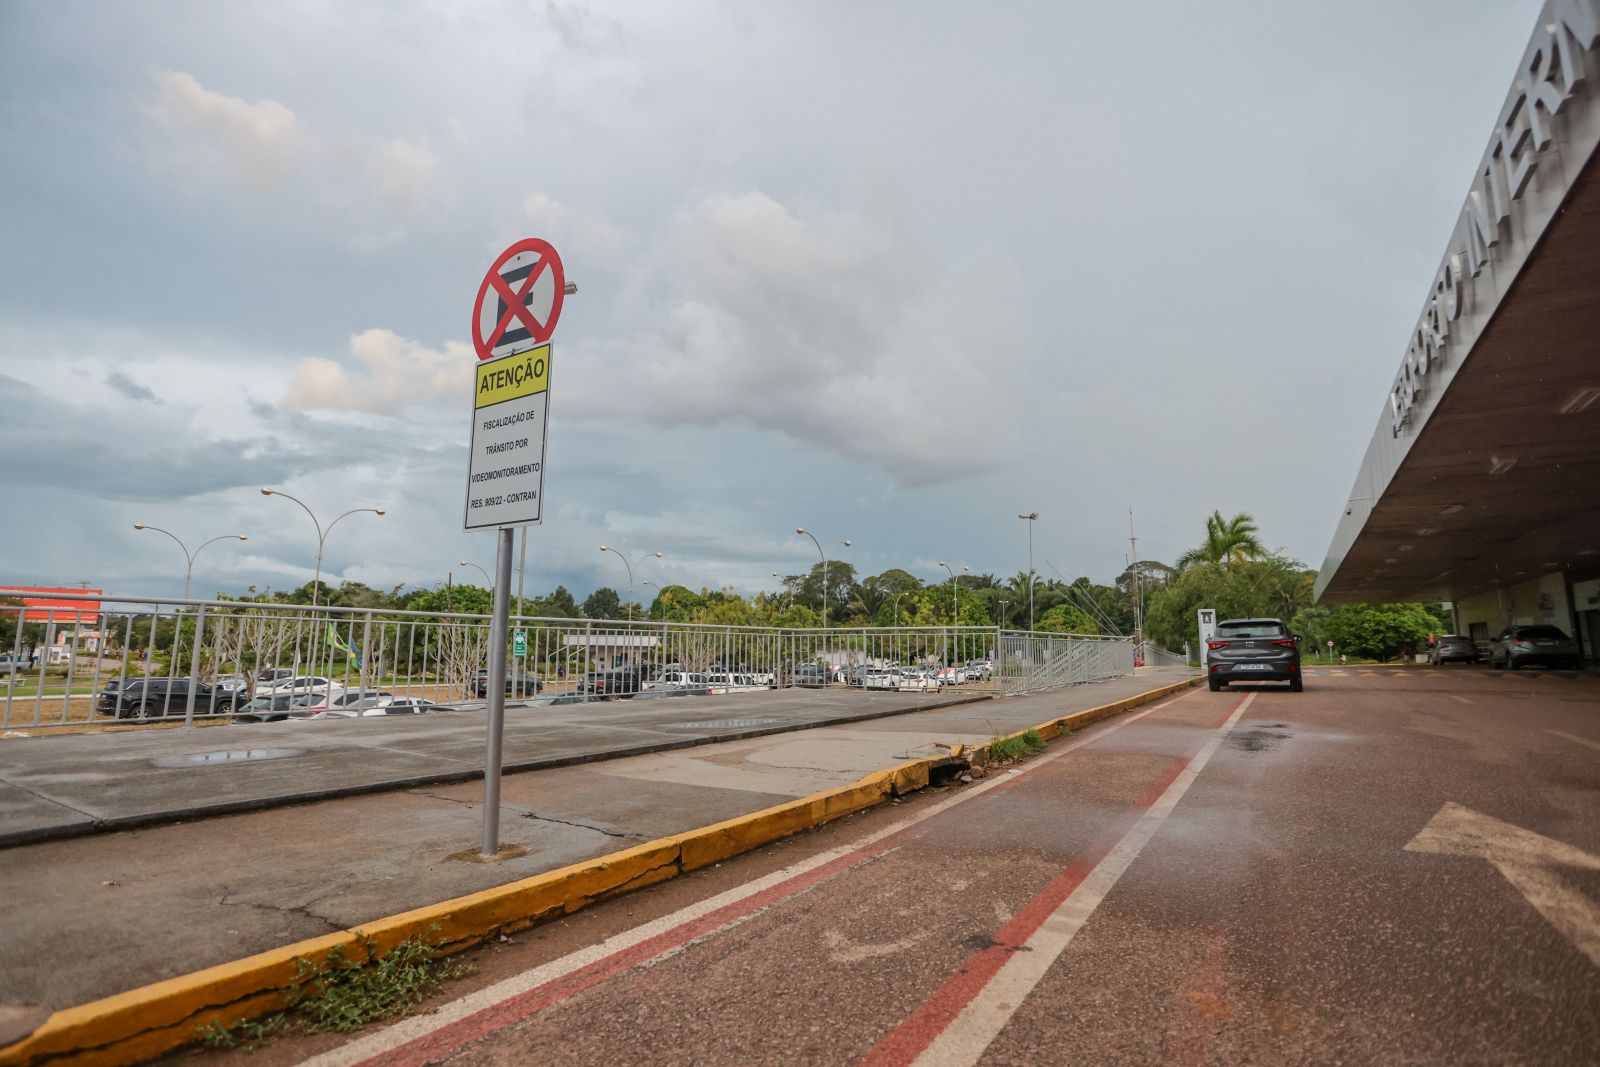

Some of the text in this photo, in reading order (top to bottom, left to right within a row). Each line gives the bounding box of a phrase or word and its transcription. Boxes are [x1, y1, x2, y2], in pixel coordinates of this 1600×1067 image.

[480, 357, 545, 393] ATENÇÃO
[483, 410, 535, 430] FISCALIZAÇÃO DE
[486, 438, 528, 455] TRÂNSITO POR
[472, 462, 540, 483] VIDEOMONITORAMENTO
[471, 498, 484, 509] RES.
[485, 495, 503, 507] 909/22
[507, 489, 537, 504] CONTRAN
